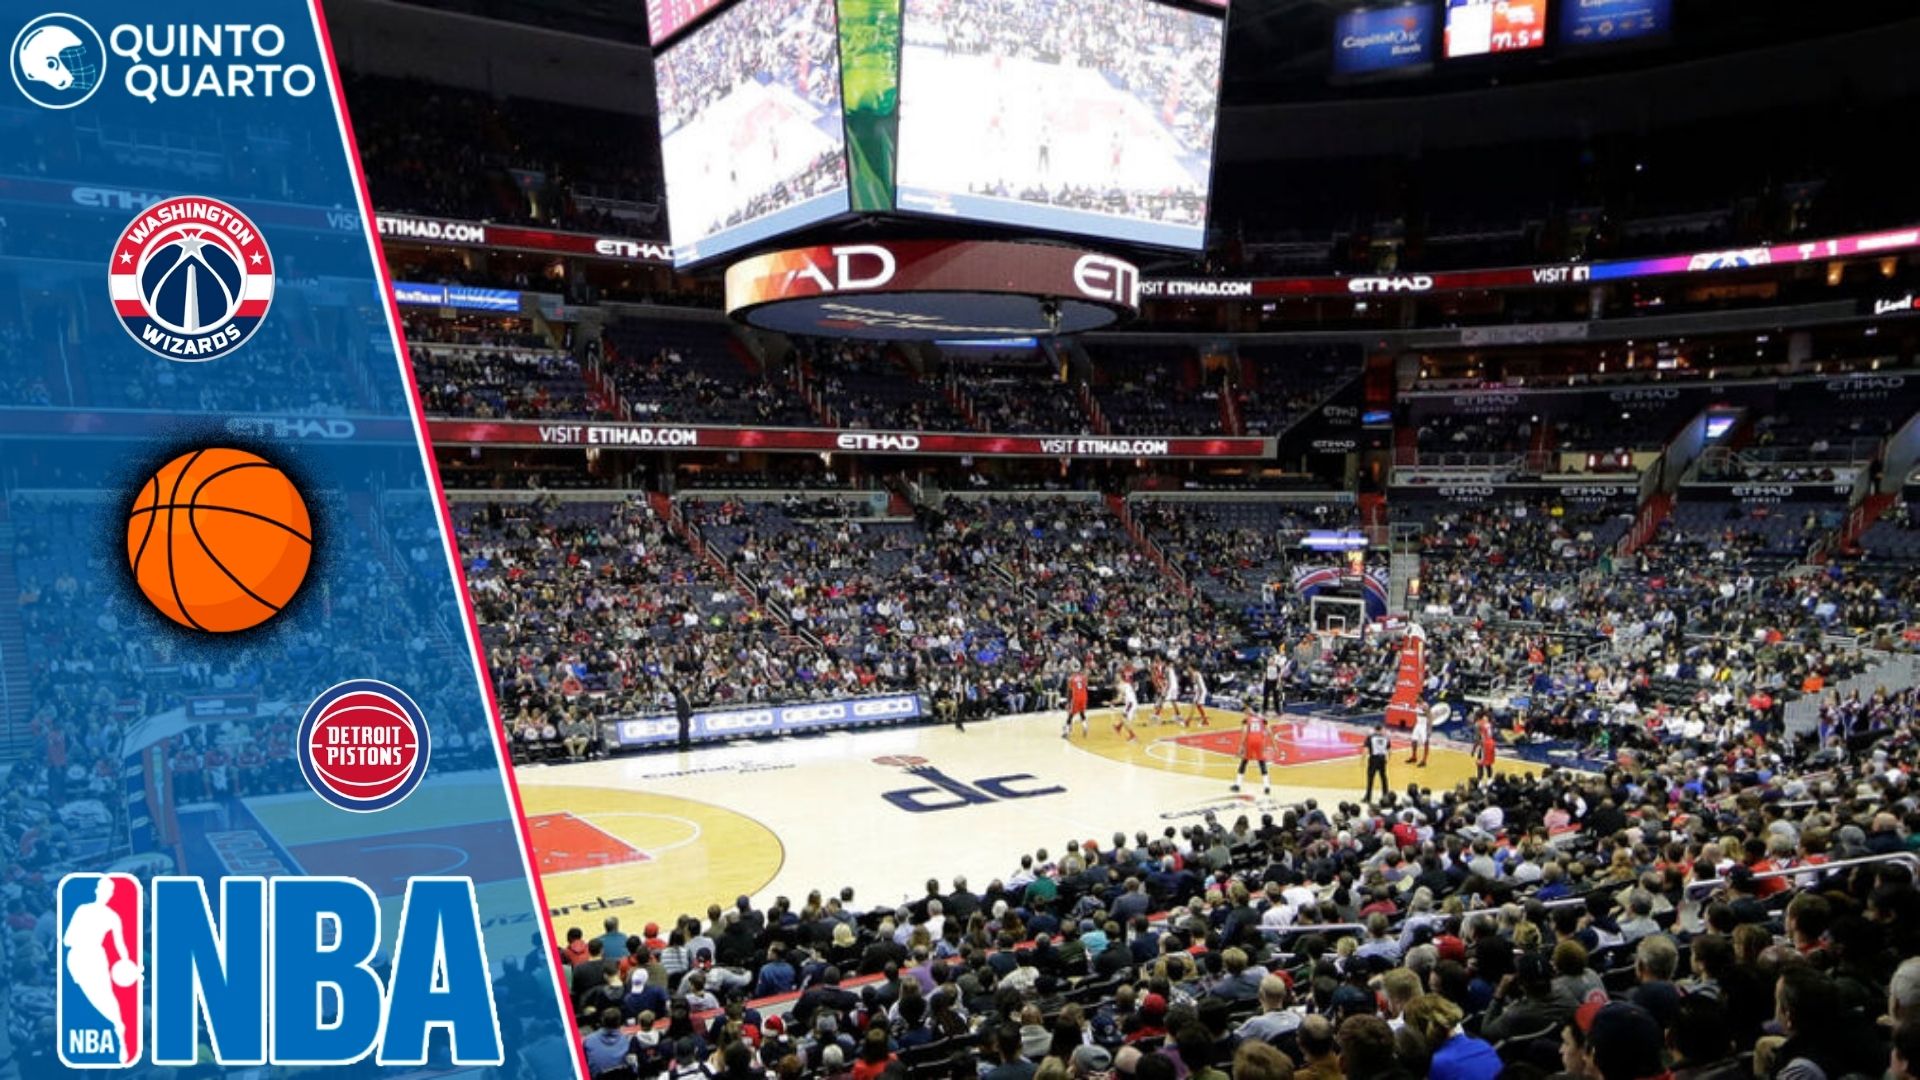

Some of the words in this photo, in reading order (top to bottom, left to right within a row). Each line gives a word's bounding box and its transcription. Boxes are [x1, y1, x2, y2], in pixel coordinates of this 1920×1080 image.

[376, 217, 485, 243] ETIHAD.COM
[1532, 267, 1568, 283] VISIT
[1167, 280, 1252, 295] ETIHAD.COM
[1348, 276, 1434, 292] ETIHAD
[539, 427, 582, 444] VISIT
[587, 429, 698, 446] ETIHAD.COM
[837, 433, 919, 451] ETIHAD
[1311, 439, 1356, 449] ETIHAD
[1040, 440, 1073, 454] VISIT
[1077, 440, 1168, 455] ETIHAD.COM
[1438, 486, 1494, 497] ETIHAD
[1560, 486, 1618, 497] ETIHAD
[1731, 486, 1794, 497] ETIHAD
[704, 710, 775, 731] GEICO
